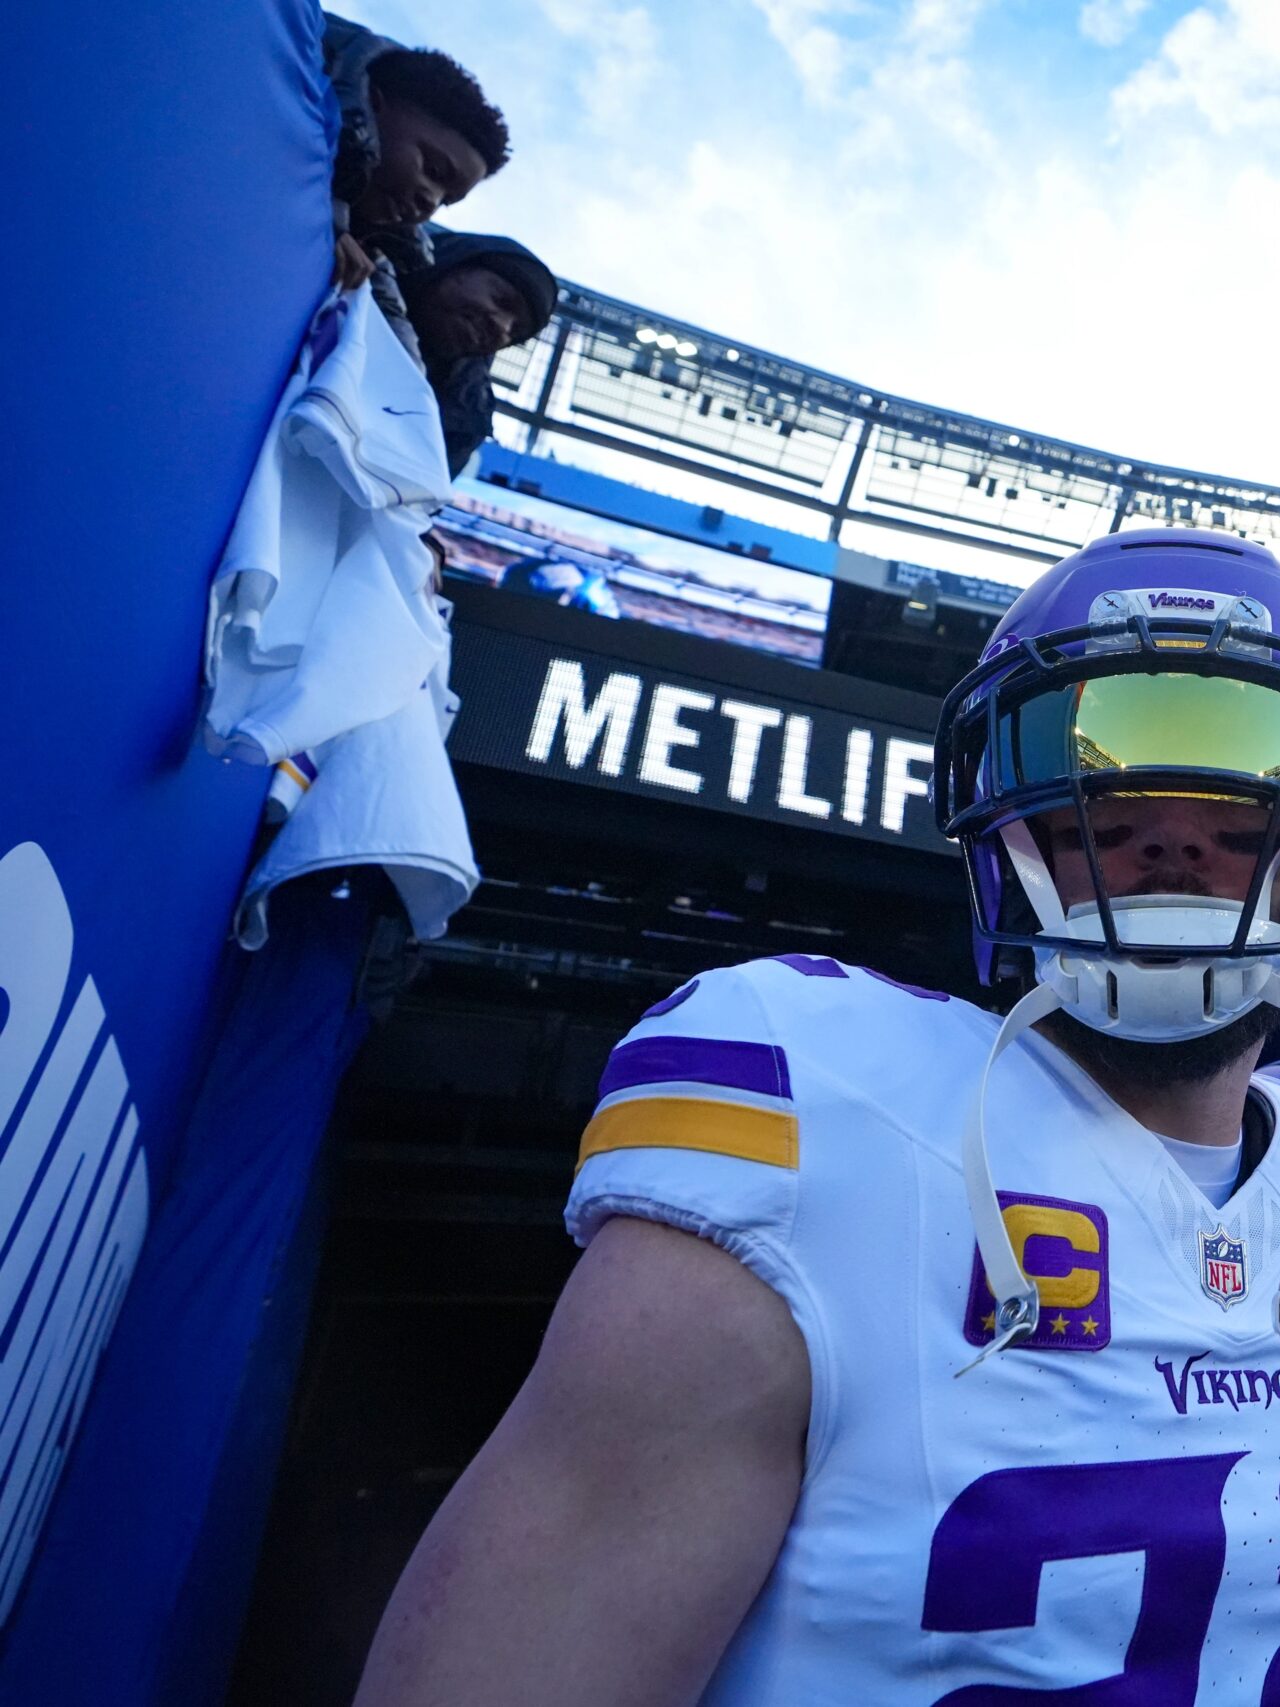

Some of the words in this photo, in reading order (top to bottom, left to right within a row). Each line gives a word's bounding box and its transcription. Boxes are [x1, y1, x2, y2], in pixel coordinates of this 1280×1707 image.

[524, 657, 935, 834] METLIF
[985, 1204, 1101, 1309] C
[1208, 1261, 1242, 1295] NFL
